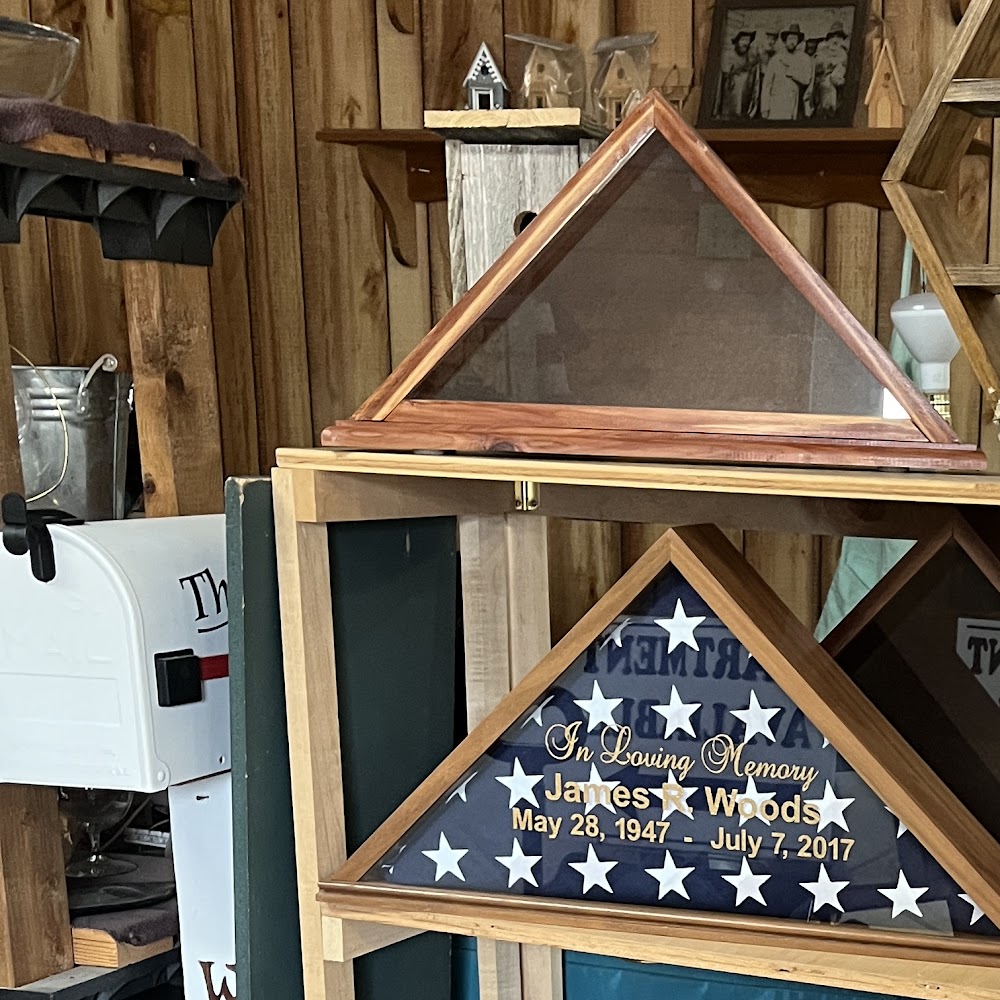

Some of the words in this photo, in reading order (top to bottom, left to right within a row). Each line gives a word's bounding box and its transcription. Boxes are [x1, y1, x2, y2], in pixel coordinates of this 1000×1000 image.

[179, 568, 229, 621] Th
[544, 720, 595, 762] In
[599, 723, 696, 781] Loving
[701, 732, 820, 792] Memory
[544, 773, 650, 810] James
[662, 782, 693, 814] R.
[705, 786, 821, 827] Woods
[511, 808, 563, 840] May
[570, 814, 606, 843] 28,
[615, 817, 671, 844] 1947
[710, 827, 763, 858] July
[771, 833, 788, 859] 7,
[797, 834, 856, 862] 2017
